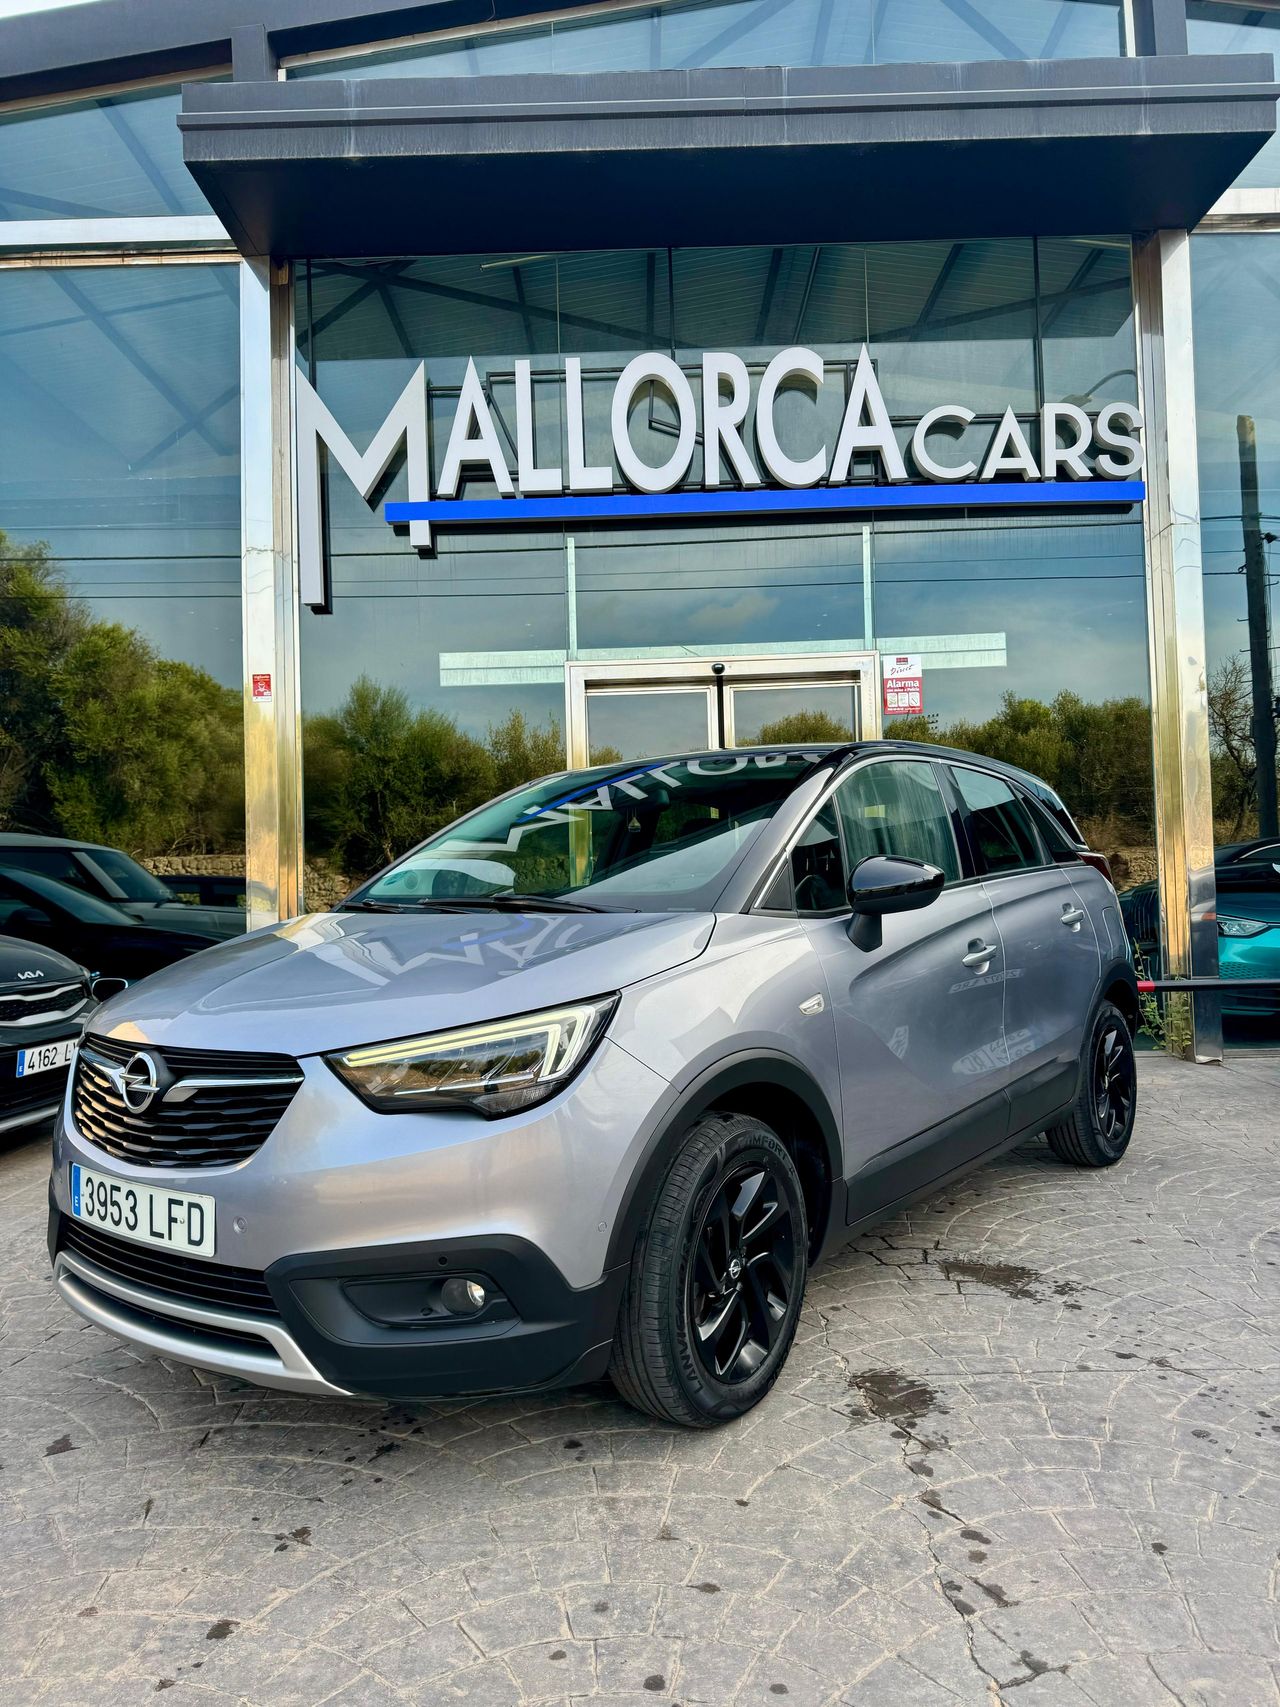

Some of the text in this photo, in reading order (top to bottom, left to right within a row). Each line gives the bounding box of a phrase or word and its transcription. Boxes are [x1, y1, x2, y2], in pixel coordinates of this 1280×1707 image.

[296, 342, 1144, 606] MALLORCA CARS
[887, 680, 919, 688] Alarma
[28, 1046, 58, 1071] 4162
[19, 1065, 23, 1073] E
[74, 1196, 79, 1207] E
[85, 1177, 204, 1247] 3953 LFD
